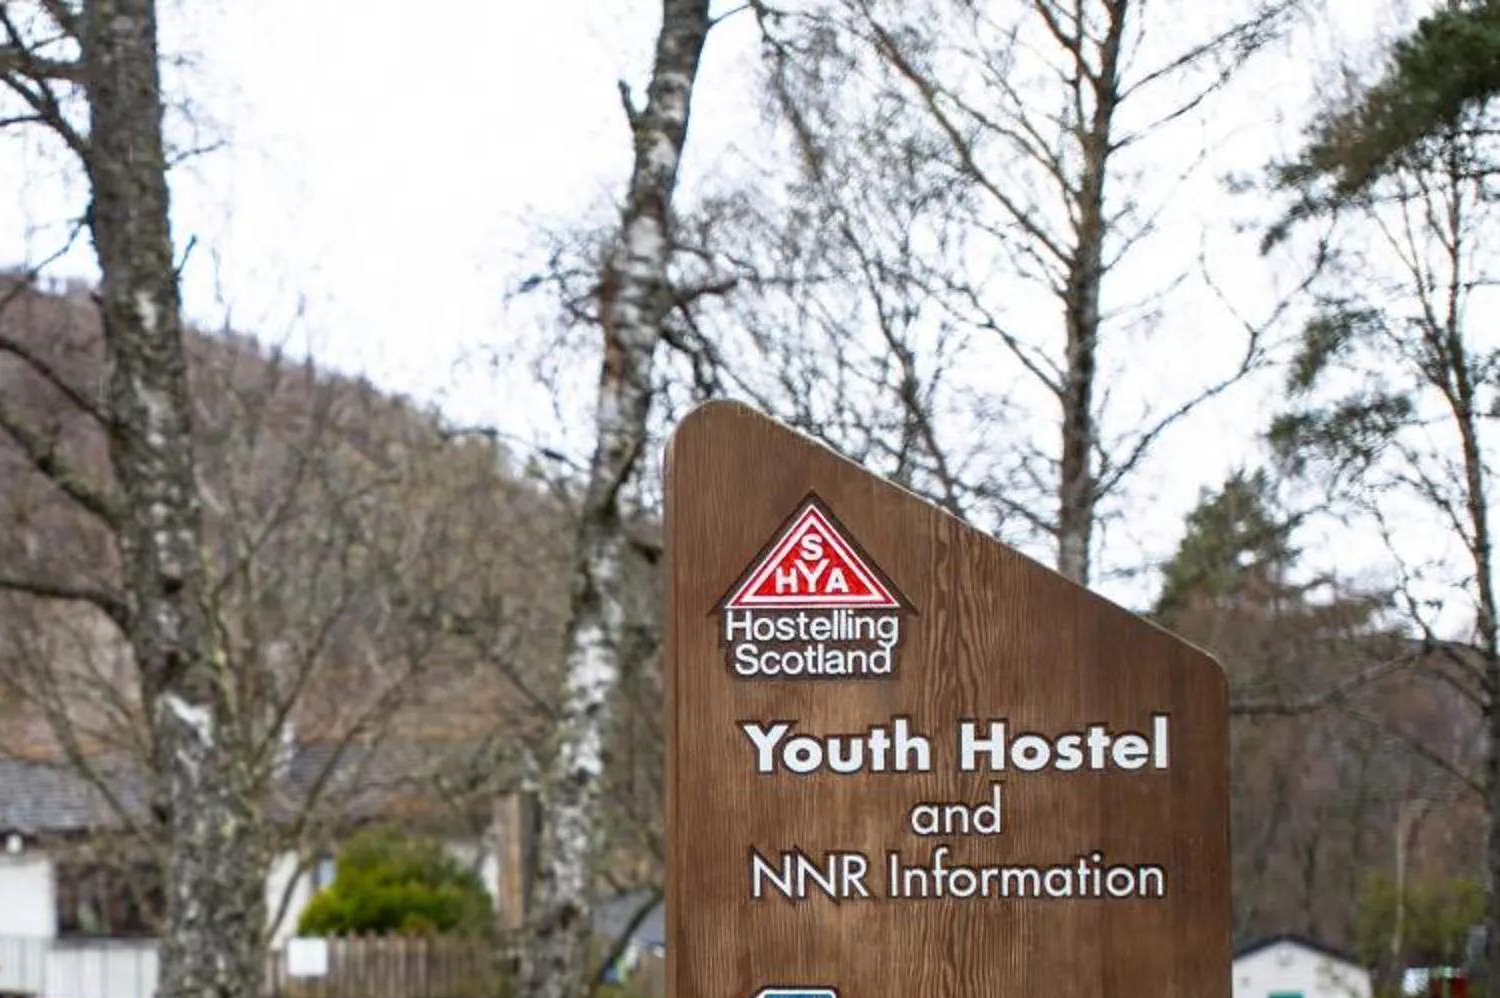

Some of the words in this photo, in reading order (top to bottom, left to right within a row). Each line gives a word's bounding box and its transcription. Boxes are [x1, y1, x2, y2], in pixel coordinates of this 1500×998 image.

[726, 609, 899, 648] Hostelling
[735, 643, 892, 675] Scotland
[743, 719, 931, 773] Youth
[961, 716, 1168, 771] Hostel
[911, 785, 1001, 835] and
[752, 854, 869, 898] NNR
[891, 847, 1164, 897] Information
